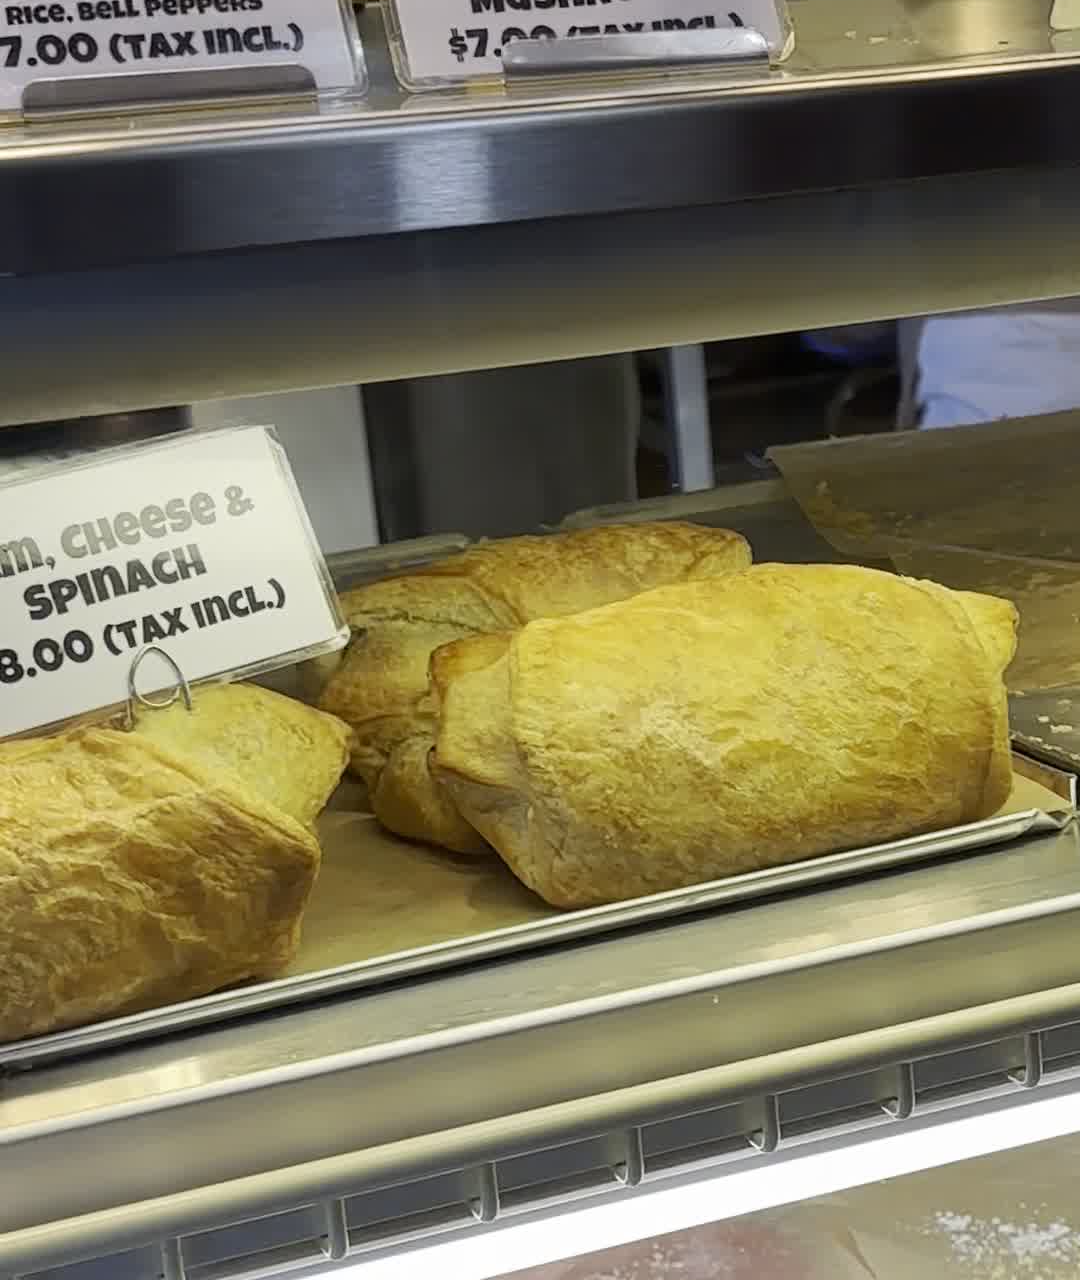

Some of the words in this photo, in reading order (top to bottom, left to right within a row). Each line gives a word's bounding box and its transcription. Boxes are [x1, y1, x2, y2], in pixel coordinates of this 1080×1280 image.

[109, 30, 198, 63] (TAX
[224, 485, 255, 517] &
[103, 606, 189, 656] (TAX
